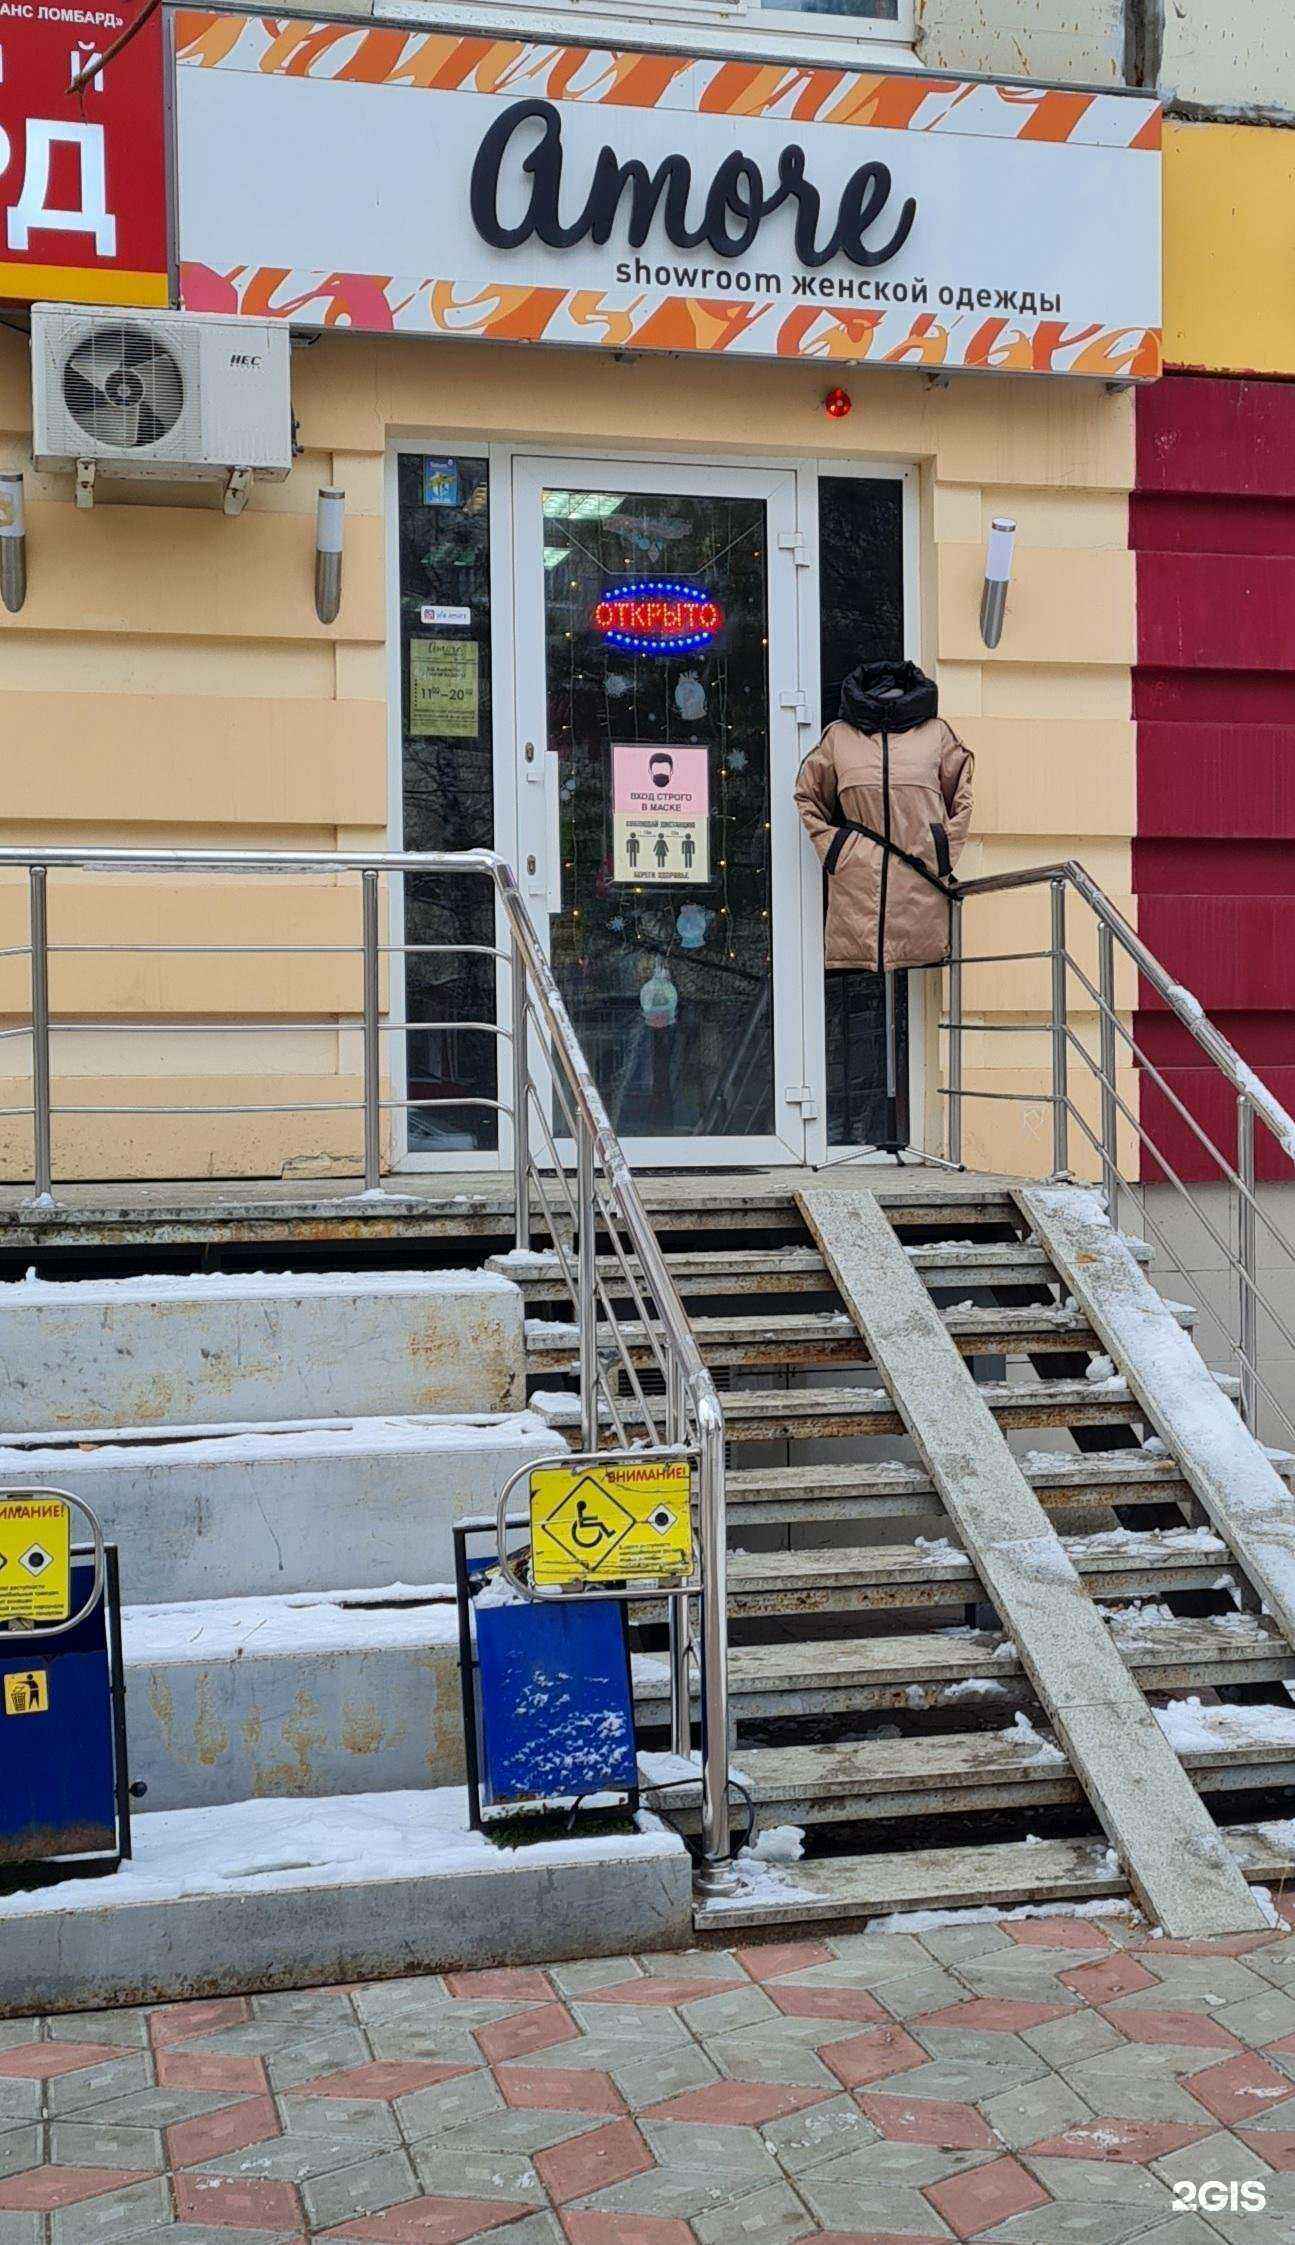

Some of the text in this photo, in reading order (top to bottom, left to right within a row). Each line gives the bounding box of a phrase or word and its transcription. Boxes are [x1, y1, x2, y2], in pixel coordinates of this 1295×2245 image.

[38, 7, 124, 28] ЛОМБАРД»
[0, 117, 117, 257] Д
[616, 257, 1062, 315] showroom женской одежды
[596, 601, 717, 627] ОТКРЫТО
[630, 792, 693, 802] ВХОД СТРОГО
[641, 803, 682, 812] В МАСКЕ
